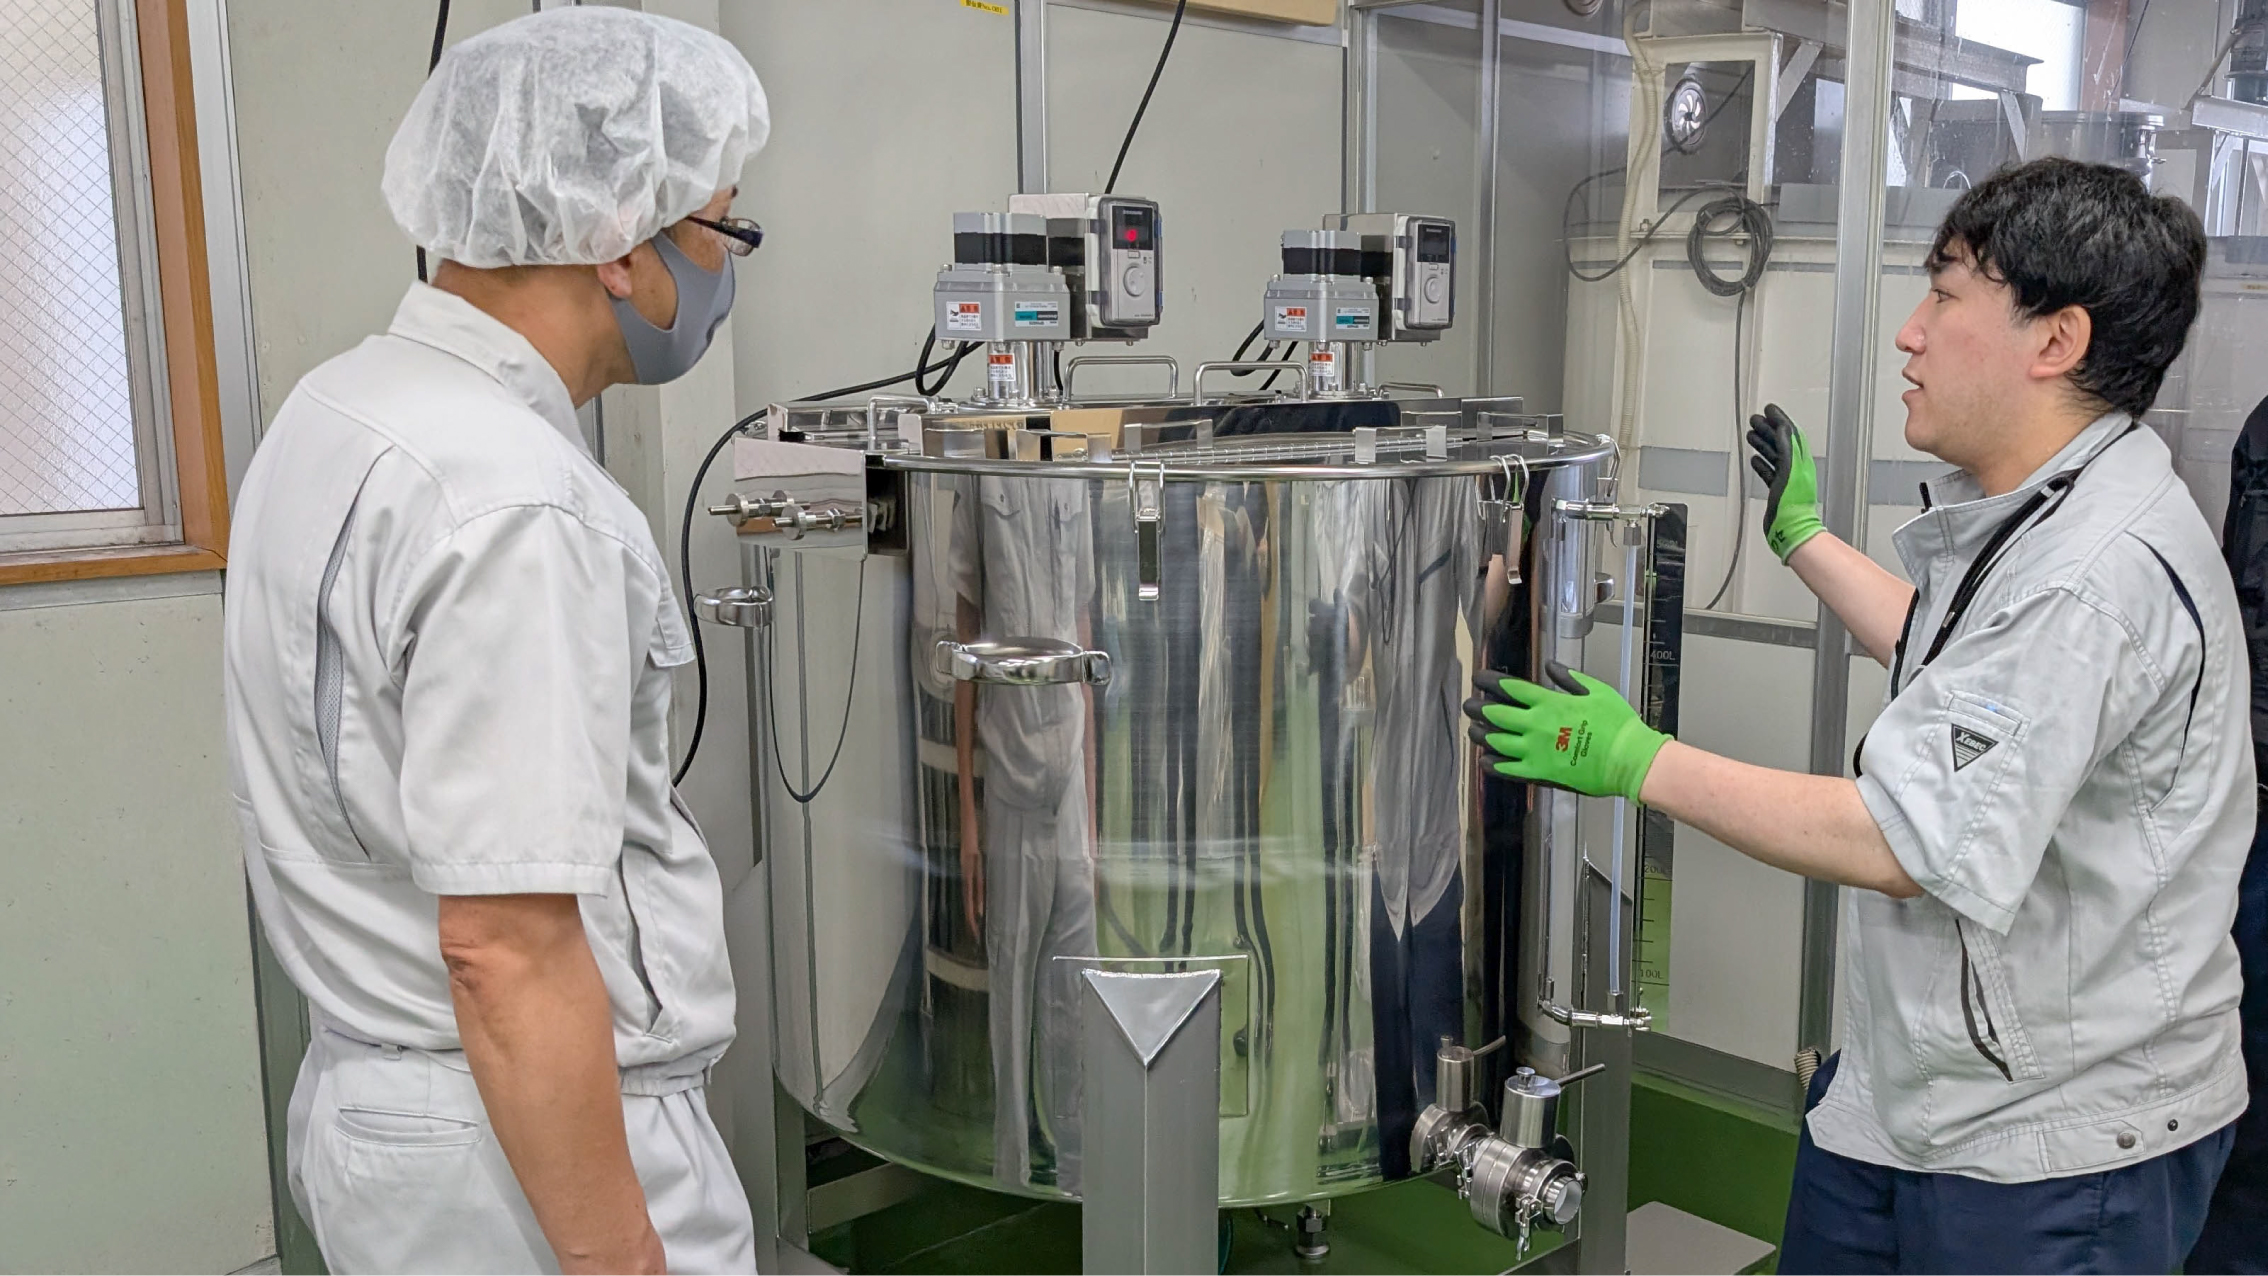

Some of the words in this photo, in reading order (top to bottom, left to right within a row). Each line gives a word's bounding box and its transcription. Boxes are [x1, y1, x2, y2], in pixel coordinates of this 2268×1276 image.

[1650, 650, 1676, 661] 400L
[1555, 727, 1572, 752] 3M
[1570, 736, 1583, 766] Comfort
[1578, 720, 1588, 735] Grip
[1580, 732, 1592, 757] Gloves
[1955, 732, 1987, 751] XEBEC
[1640, 969, 1665, 979] 100L
